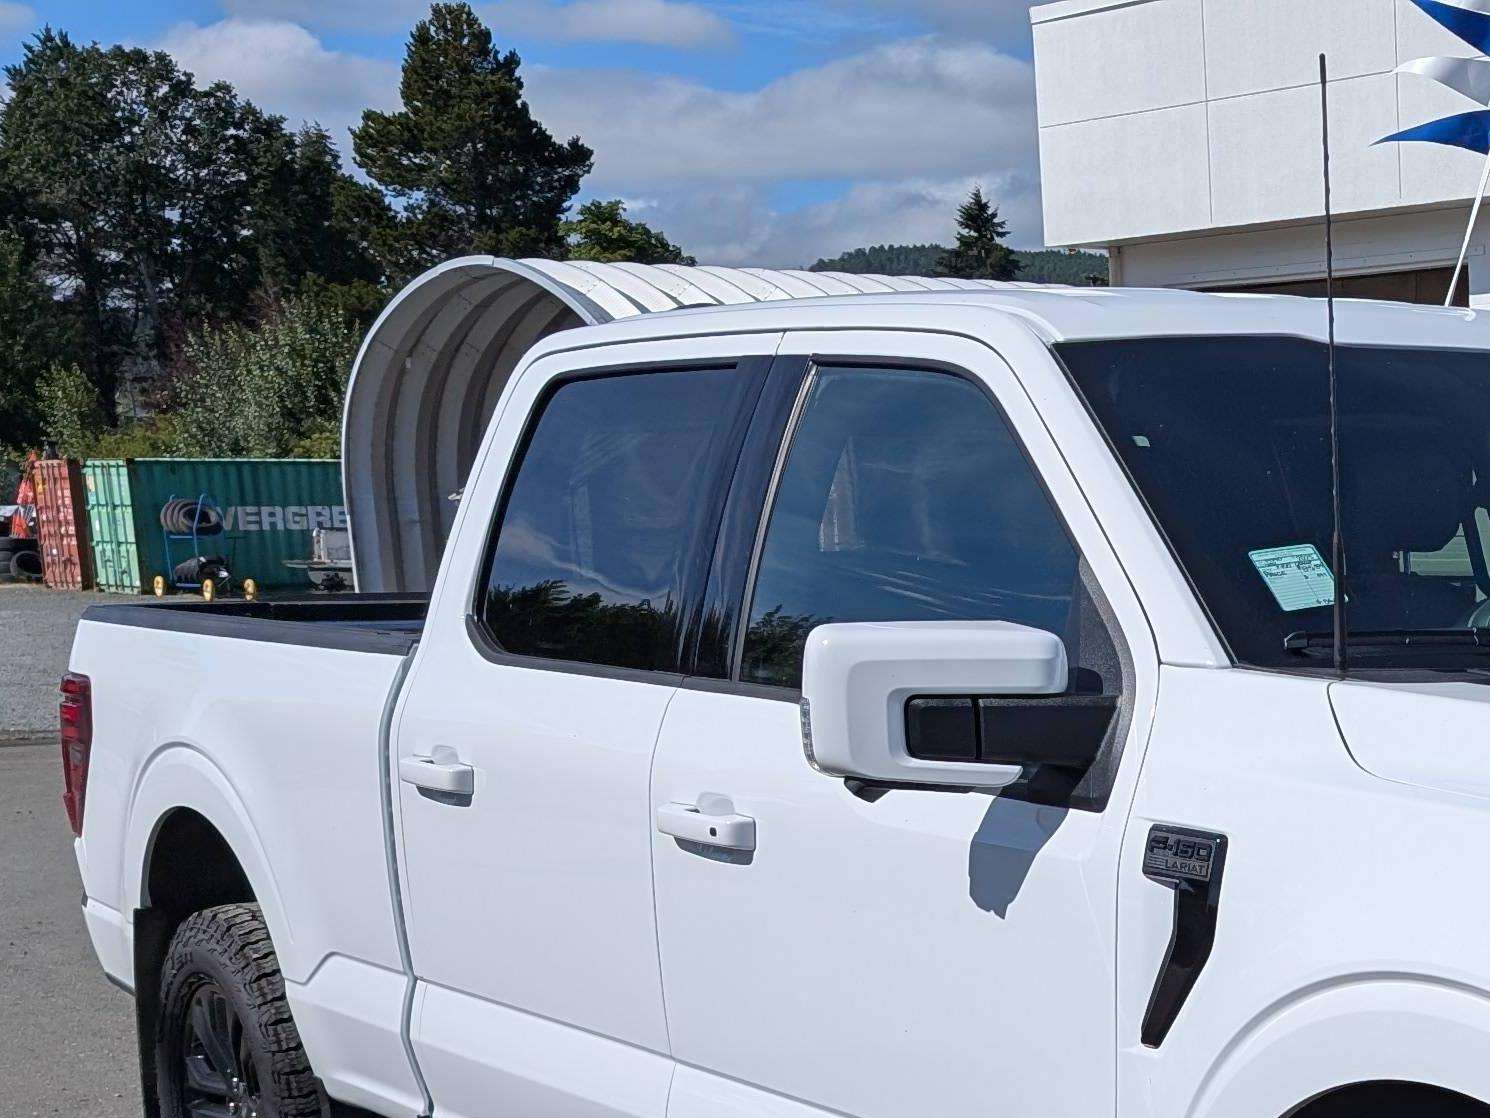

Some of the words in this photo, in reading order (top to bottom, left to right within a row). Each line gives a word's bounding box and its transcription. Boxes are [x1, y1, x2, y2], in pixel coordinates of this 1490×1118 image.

[216, 505, 348, 531] VERGRE
[1147, 835, 1213, 862] F-150
[1164, 860, 1208, 877] LARIAT
